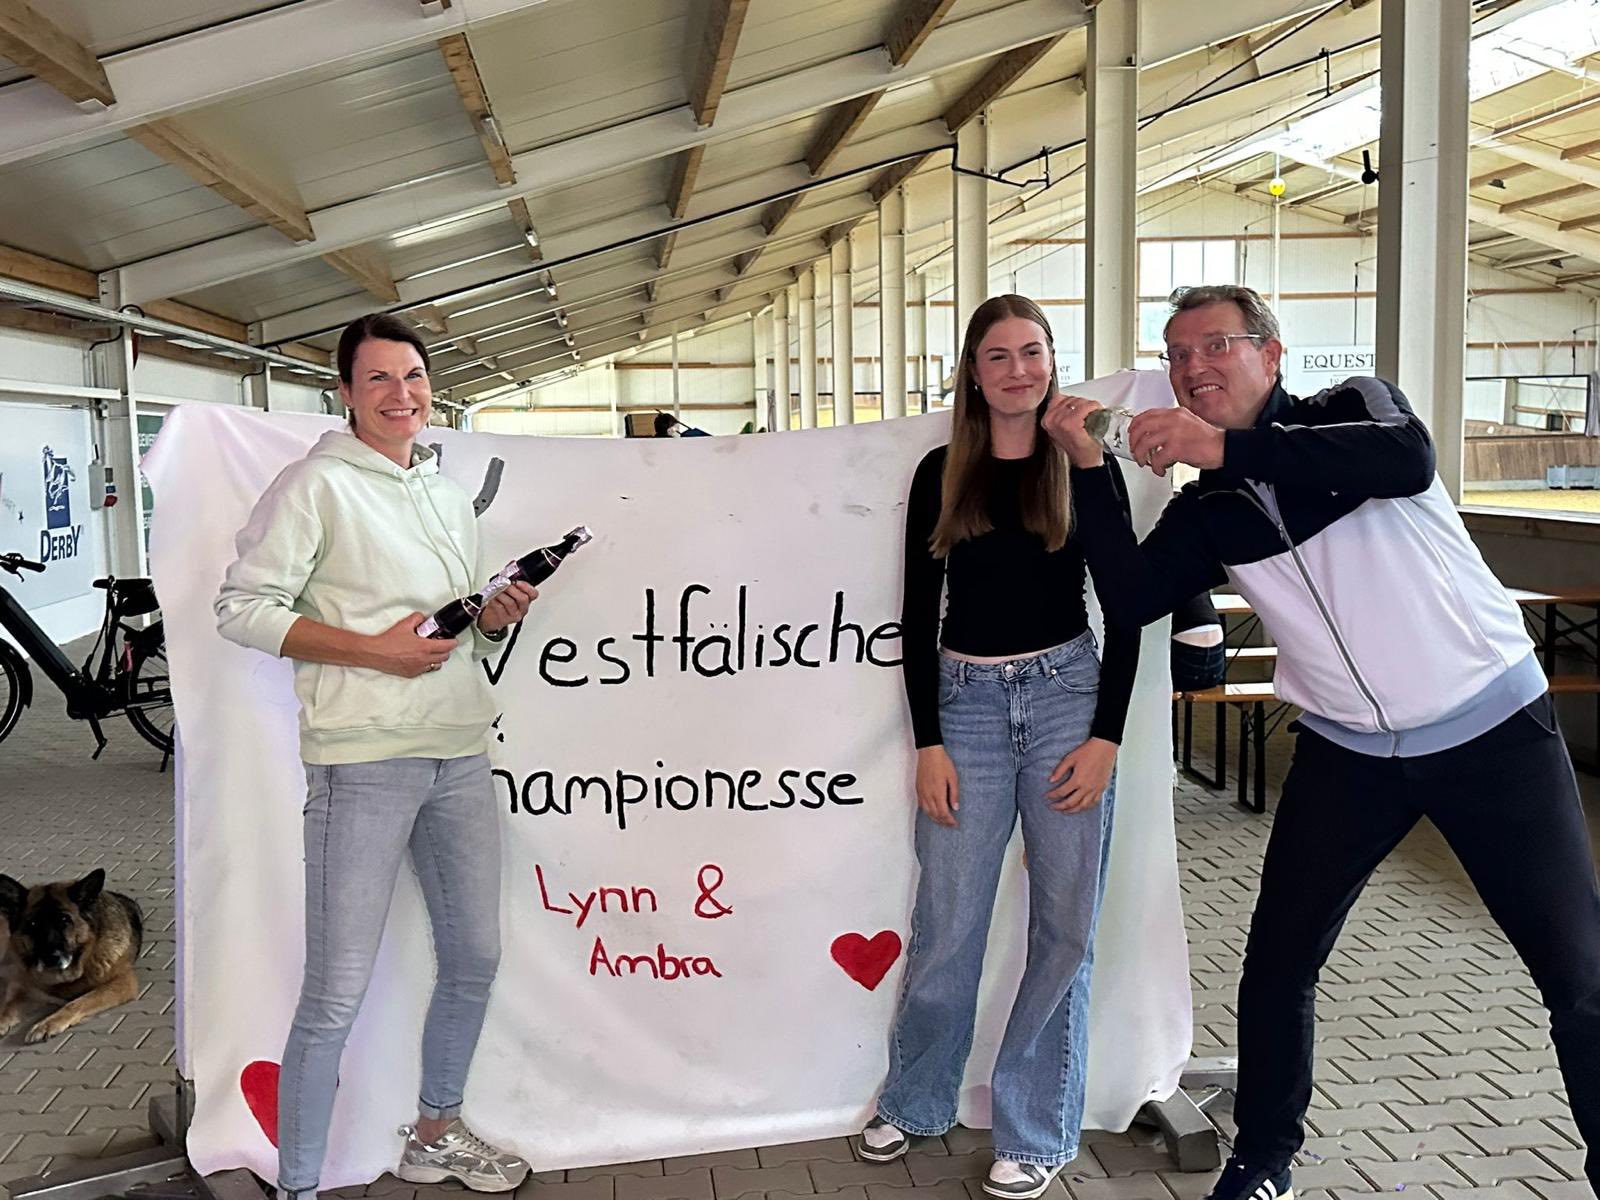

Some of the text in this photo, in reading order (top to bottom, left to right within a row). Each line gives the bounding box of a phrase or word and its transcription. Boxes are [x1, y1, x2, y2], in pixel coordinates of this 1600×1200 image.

[40, 524, 81, 563] DERBY
[490, 760, 864, 830] ampionesse
[535, 863, 734, 929] Lynn &
[588, 936, 723, 981] Ambra
